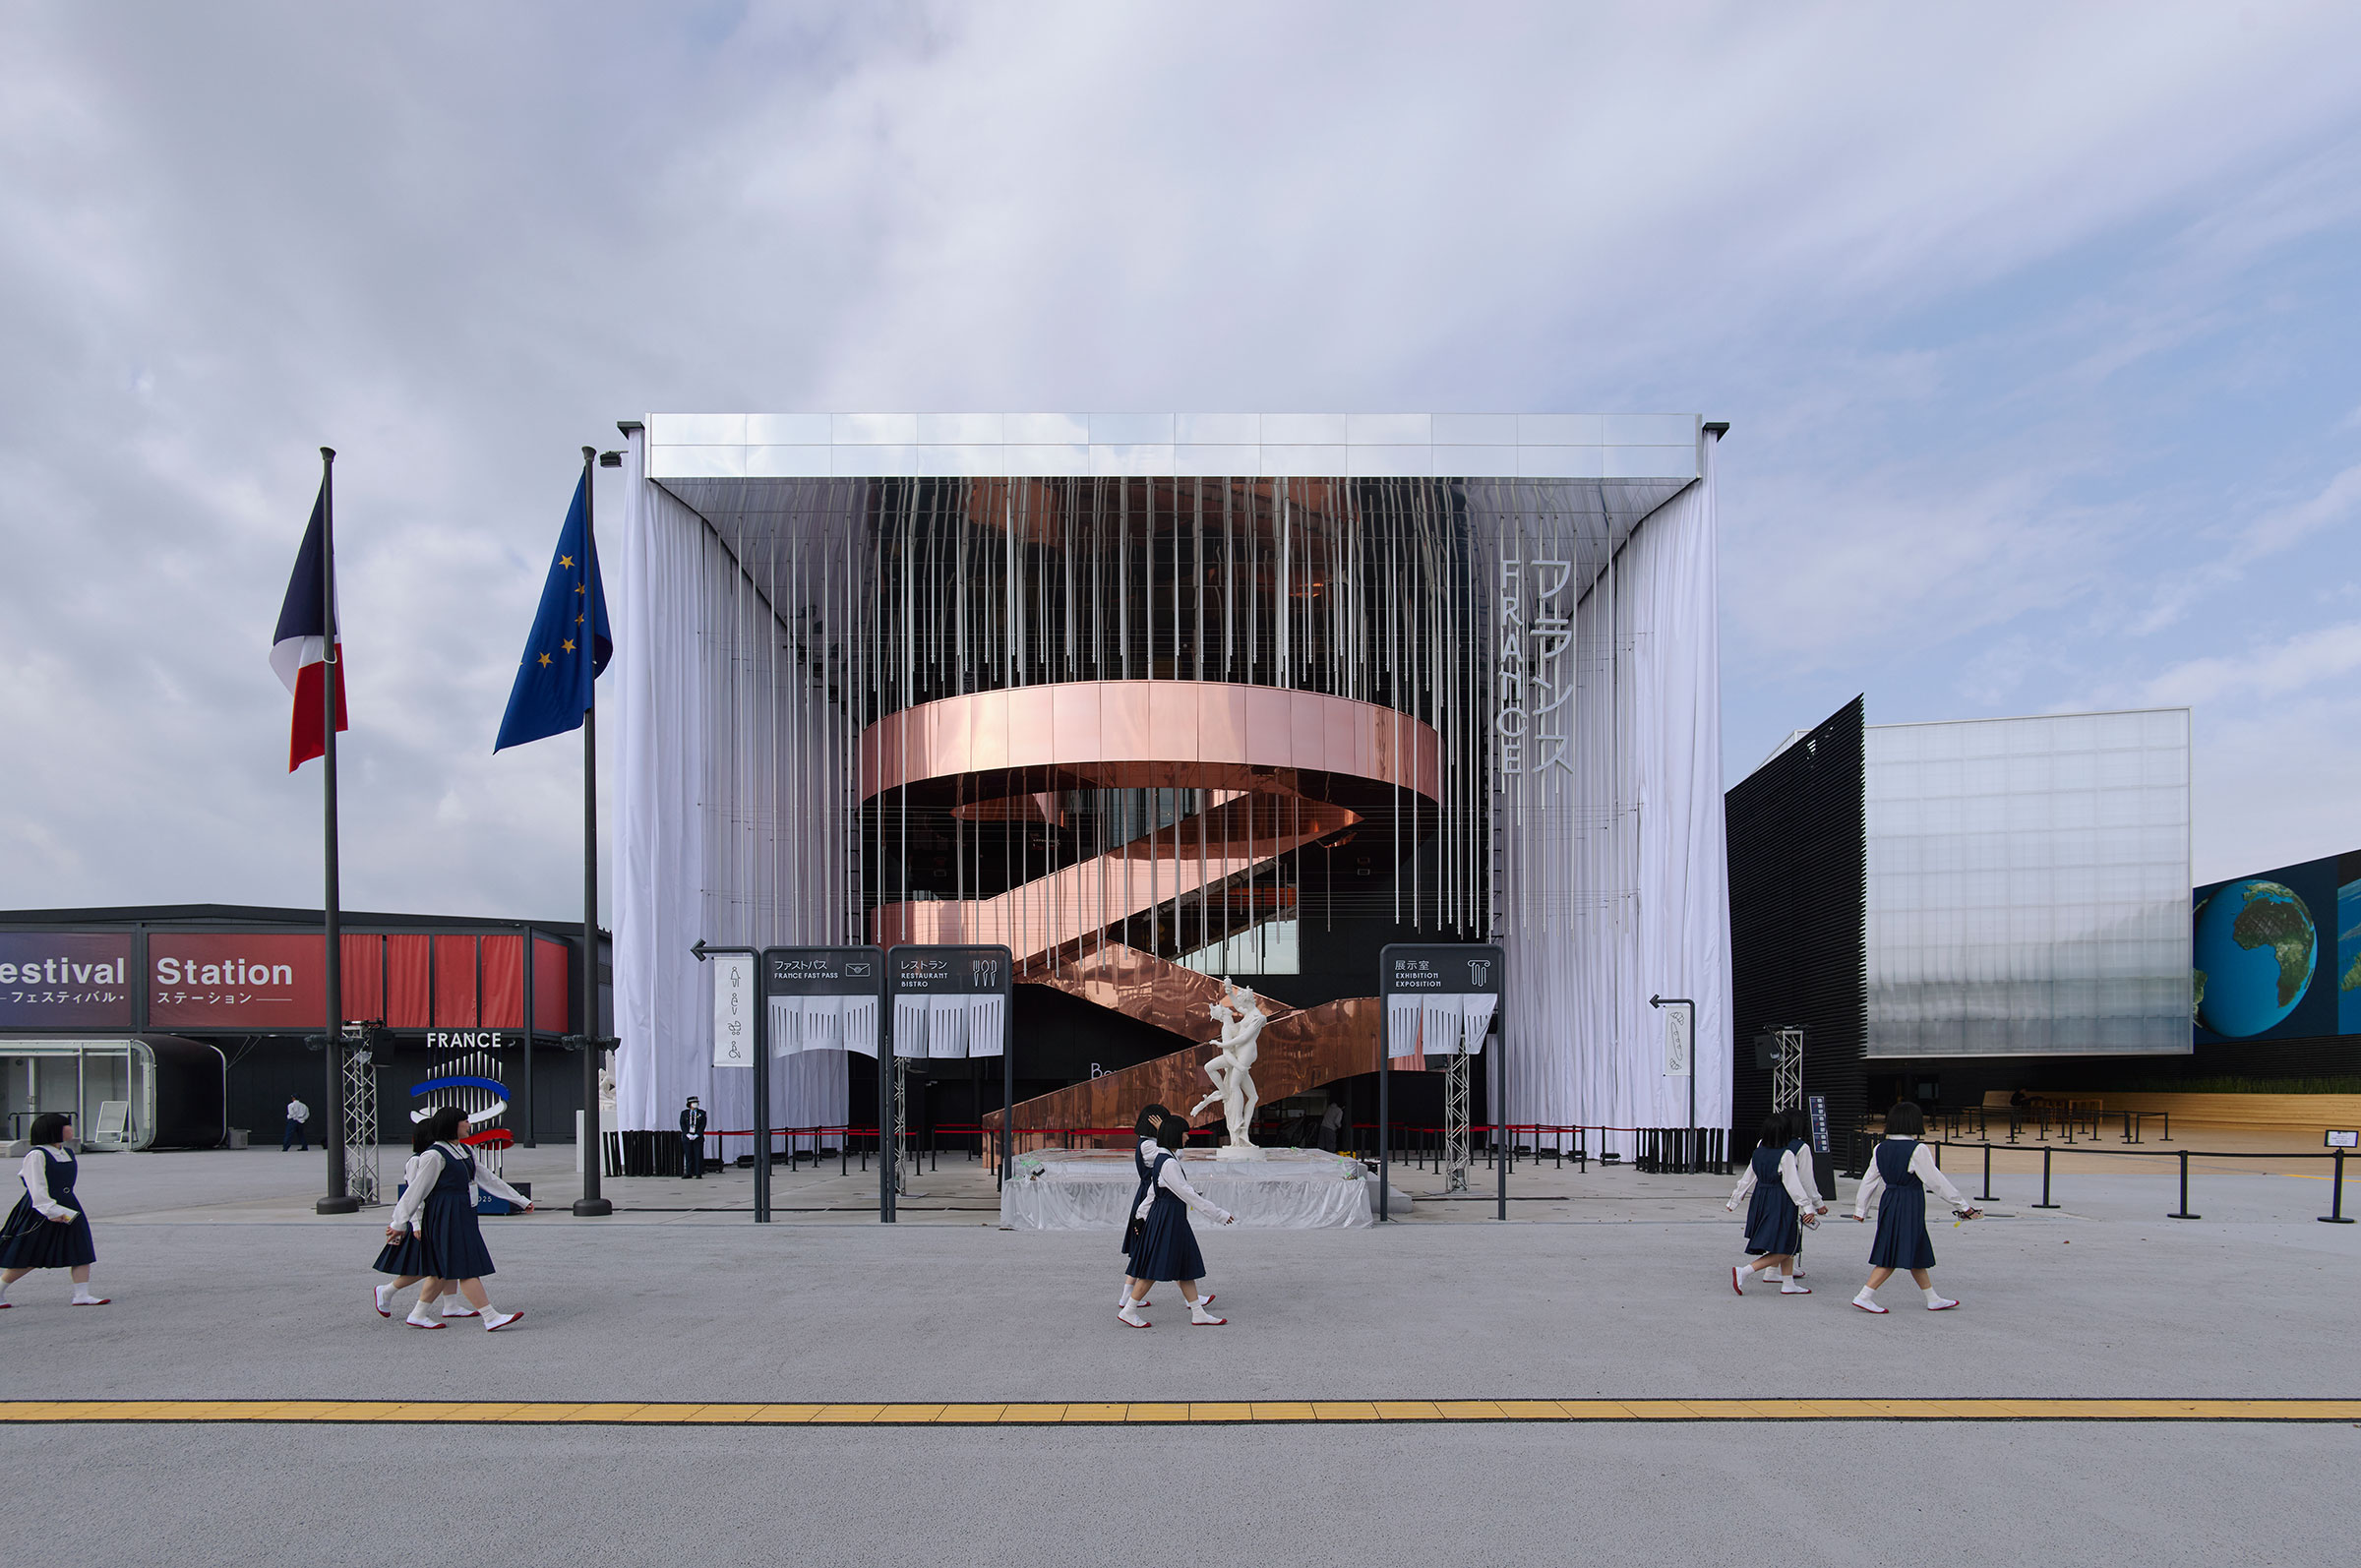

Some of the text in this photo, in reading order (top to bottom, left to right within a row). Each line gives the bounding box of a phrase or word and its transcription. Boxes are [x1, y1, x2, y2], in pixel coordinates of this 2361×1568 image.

[1496, 559, 1528, 775] FRANCE
[1530, 559, 1574, 774] フランス
[0, 957, 293, 985] estival Station
[774, 959, 827, 971] ファストパス
[901, 960, 947, 970] レストラン
[1395, 960, 1429, 971] 展示室
[157, 992, 252, 1004] ステーション
[426, 1032, 502, 1048] FRANCE
